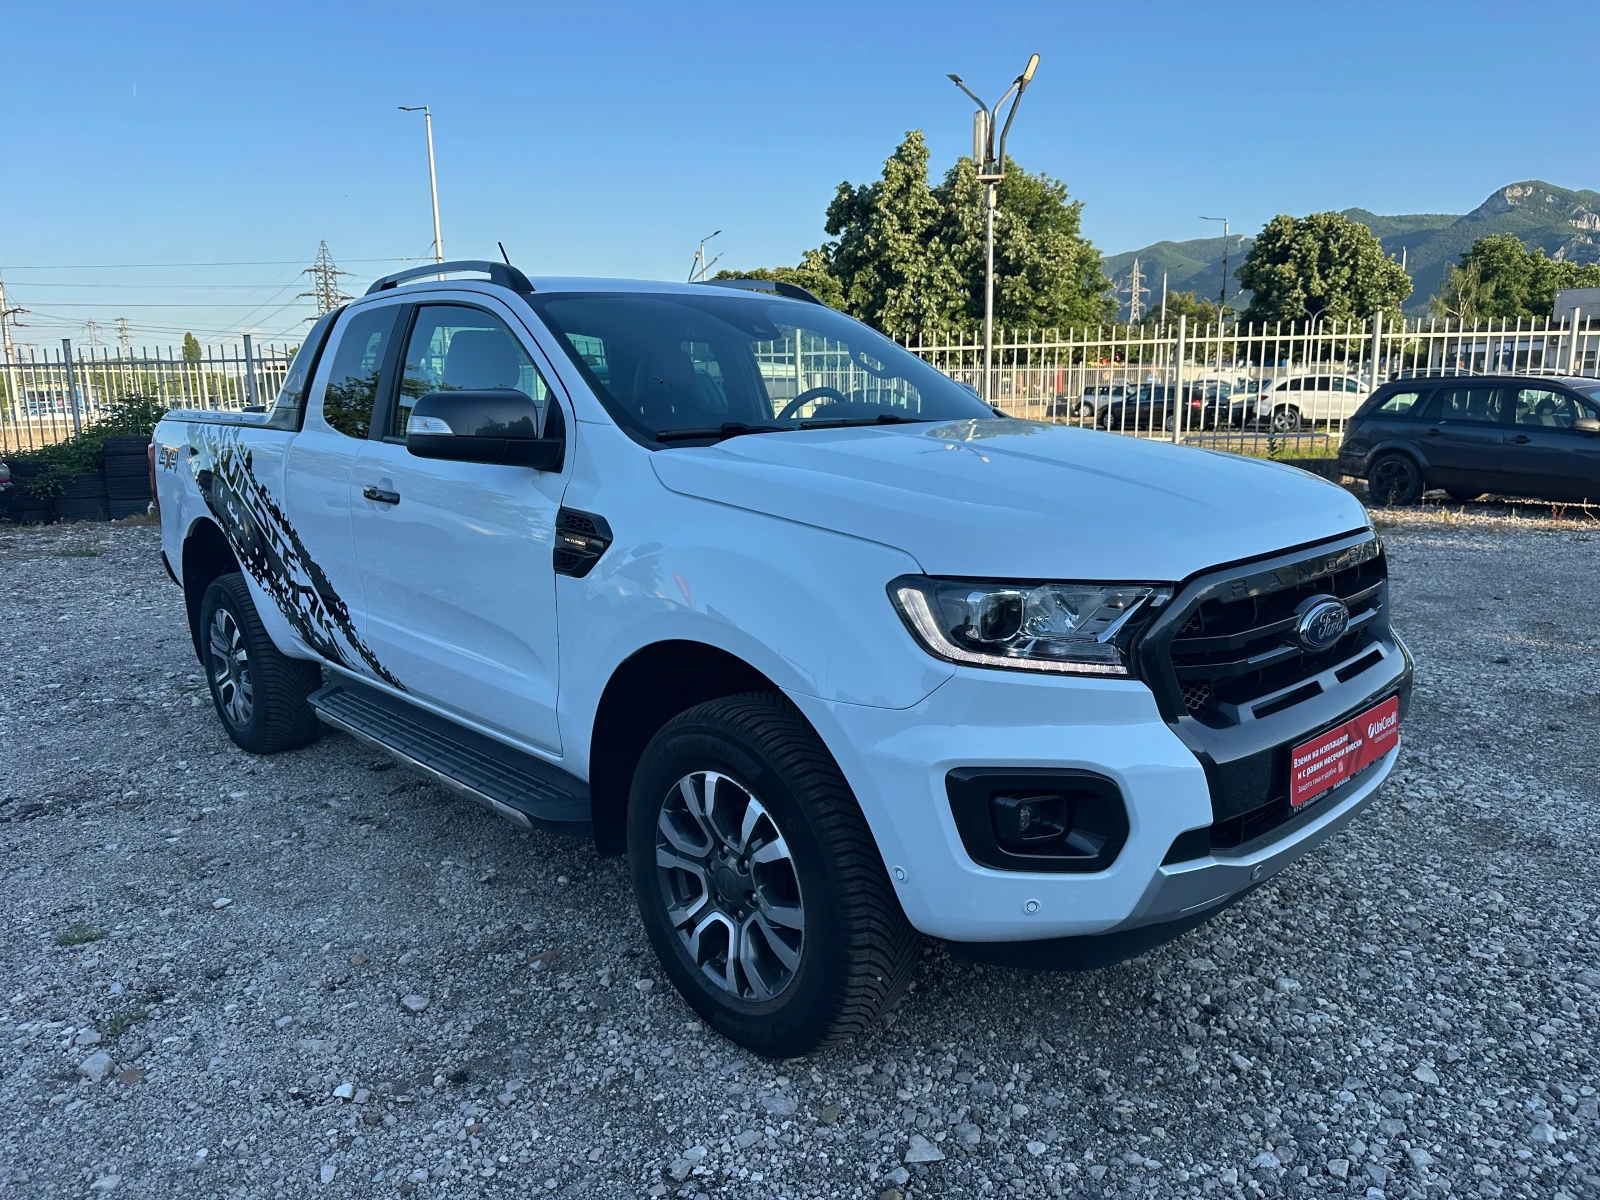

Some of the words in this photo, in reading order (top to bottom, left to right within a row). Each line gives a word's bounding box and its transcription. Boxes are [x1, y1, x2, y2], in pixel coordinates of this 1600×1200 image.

[1318, 608, 1349, 640] Ford
[1374, 711, 1397, 735] UniCredit
[1293, 752, 1312, 769] Вземи
[1312, 749, 1320, 760] на
[1319, 733, 1349, 756] изплащане
[1306, 760, 1324, 778] равни
[1323, 748, 1346, 767] месечни
[1345, 738, 1363, 754] вноски
